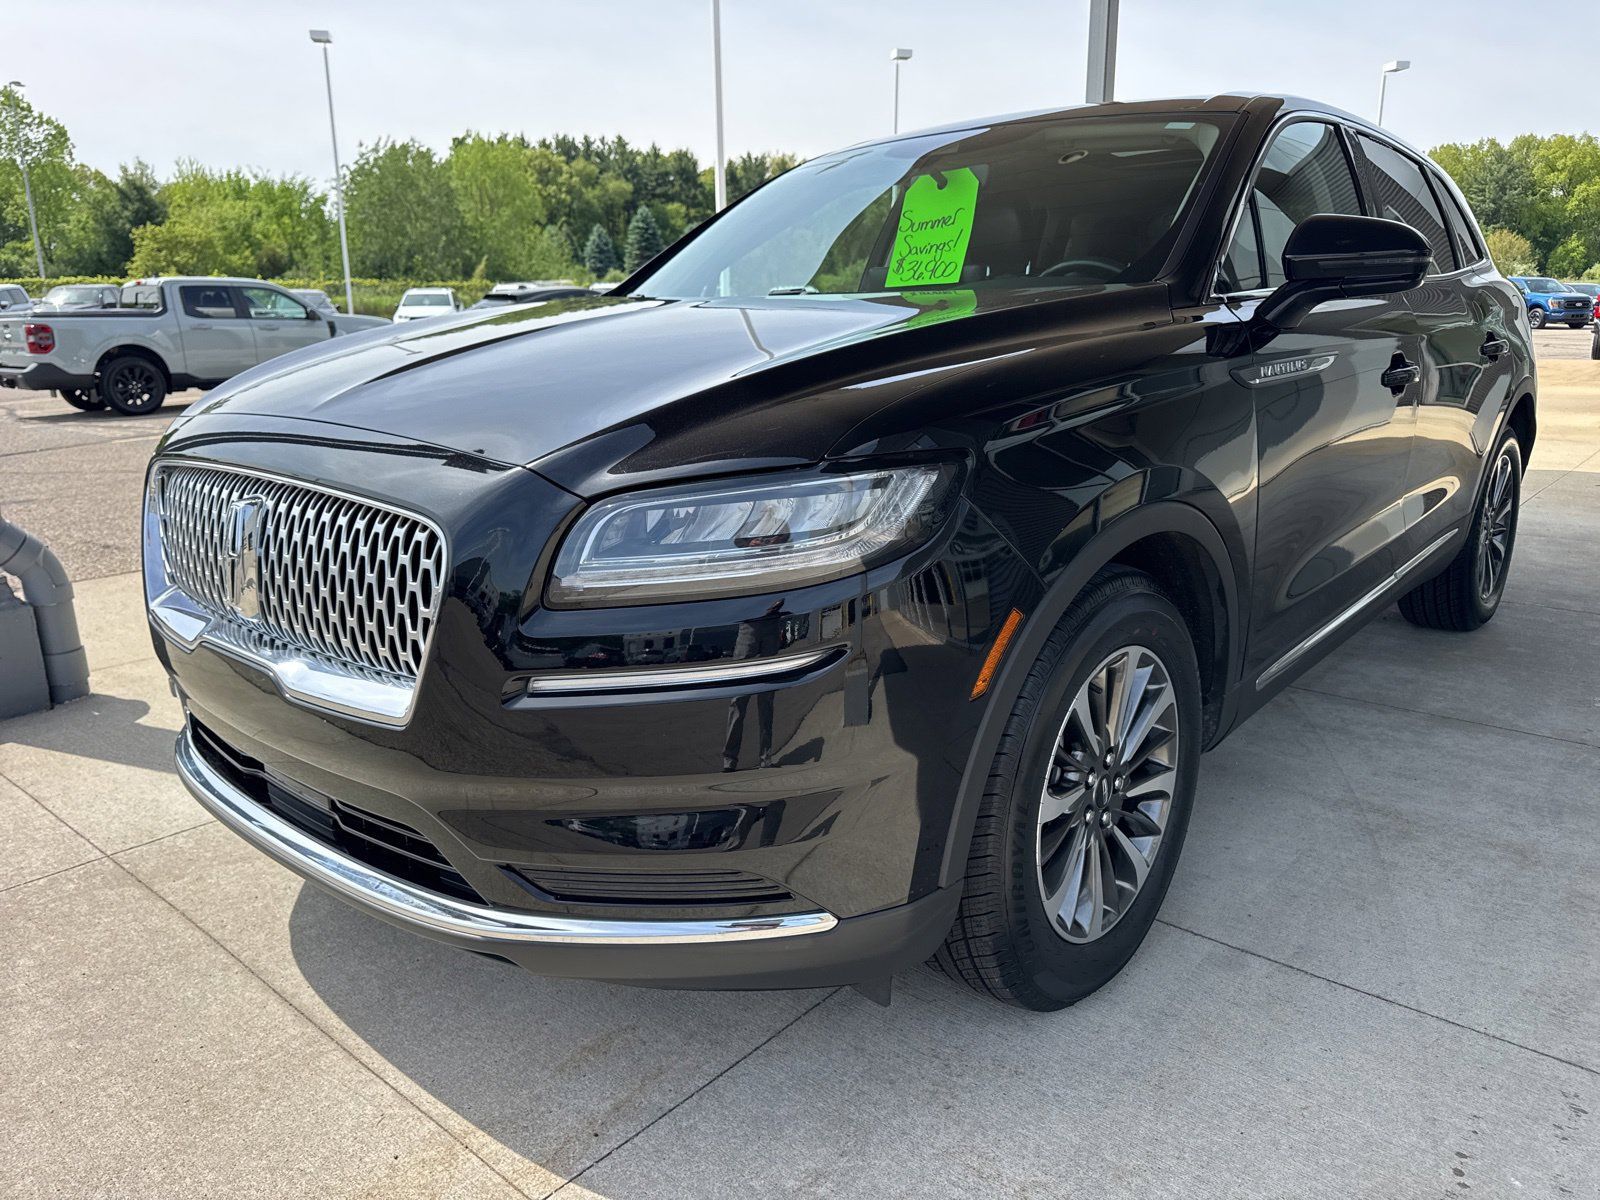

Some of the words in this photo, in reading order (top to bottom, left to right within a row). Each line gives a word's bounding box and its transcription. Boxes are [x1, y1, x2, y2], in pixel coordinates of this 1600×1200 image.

[899, 208, 965, 232] Summer
[900, 229, 963, 262] Savings!
[1260, 359, 1307, 377] NAUTILUS
